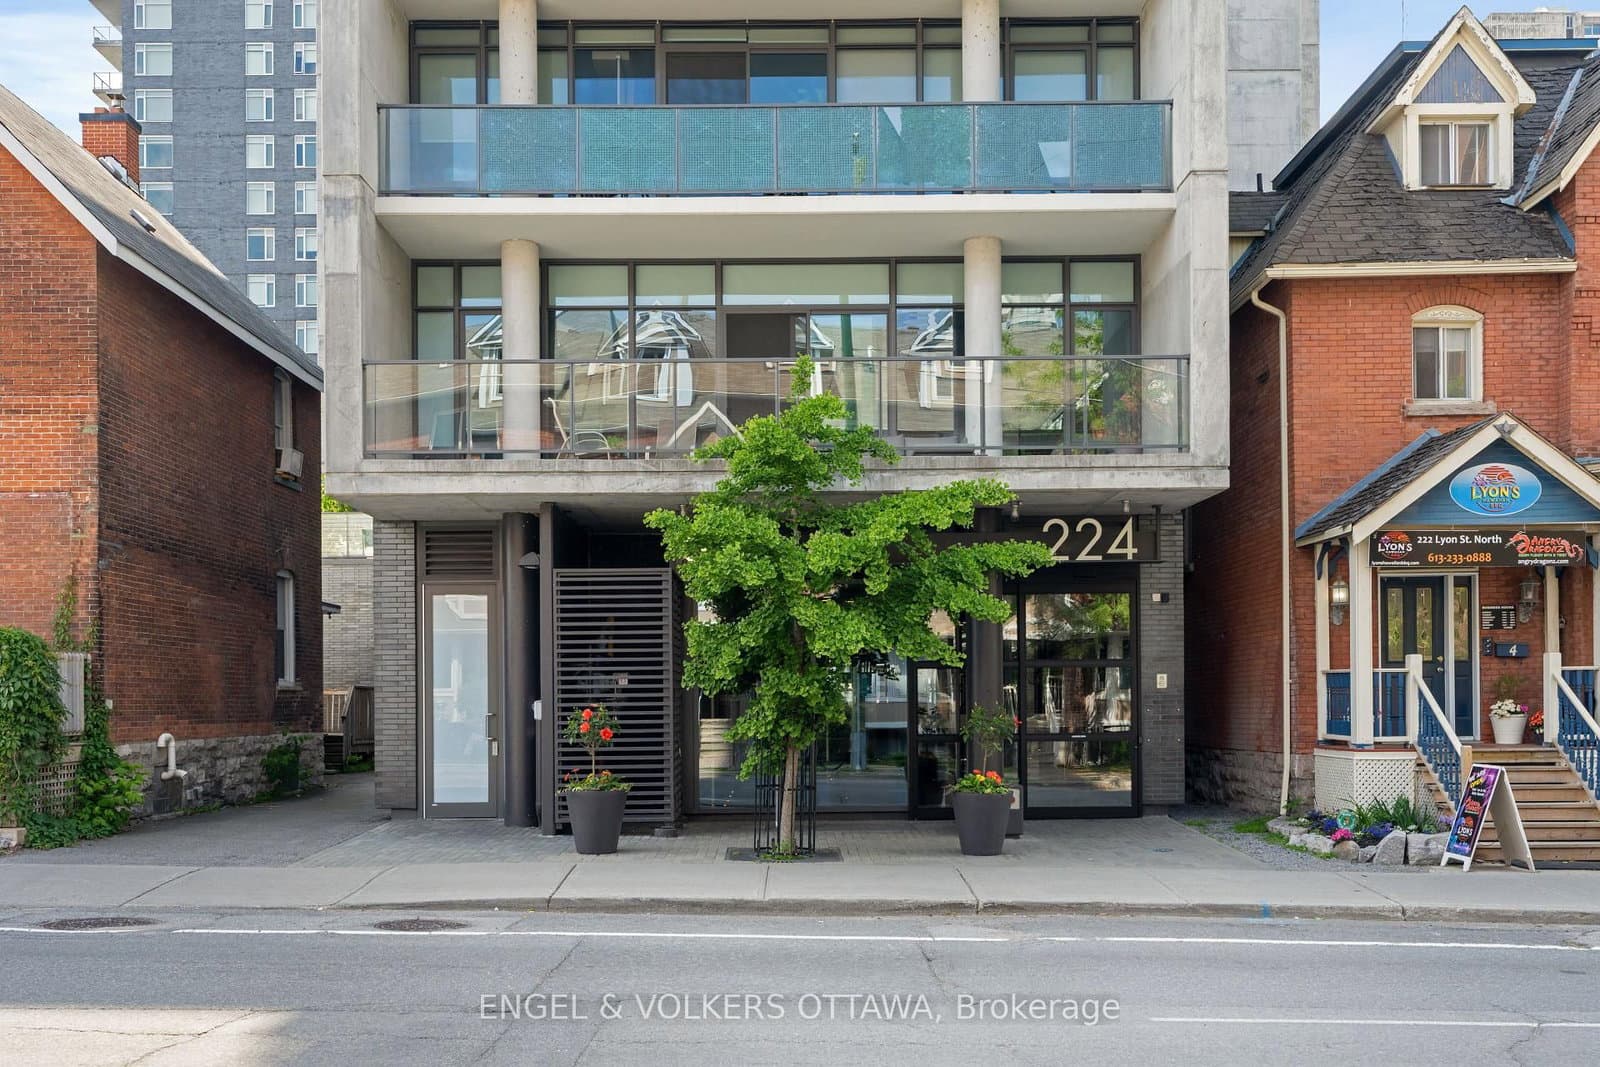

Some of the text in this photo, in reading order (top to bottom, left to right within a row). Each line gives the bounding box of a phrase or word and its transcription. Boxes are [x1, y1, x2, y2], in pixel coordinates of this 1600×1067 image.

[1472, 487, 1520, 499] LYON'S
[1043, 516, 1138, 560] 224
[1417, 534, 1502, 546] 222 Lyon St. North
[1428, 553, 1492, 564] 613-233-0888
[1509, 645, 1518, 656] 4
